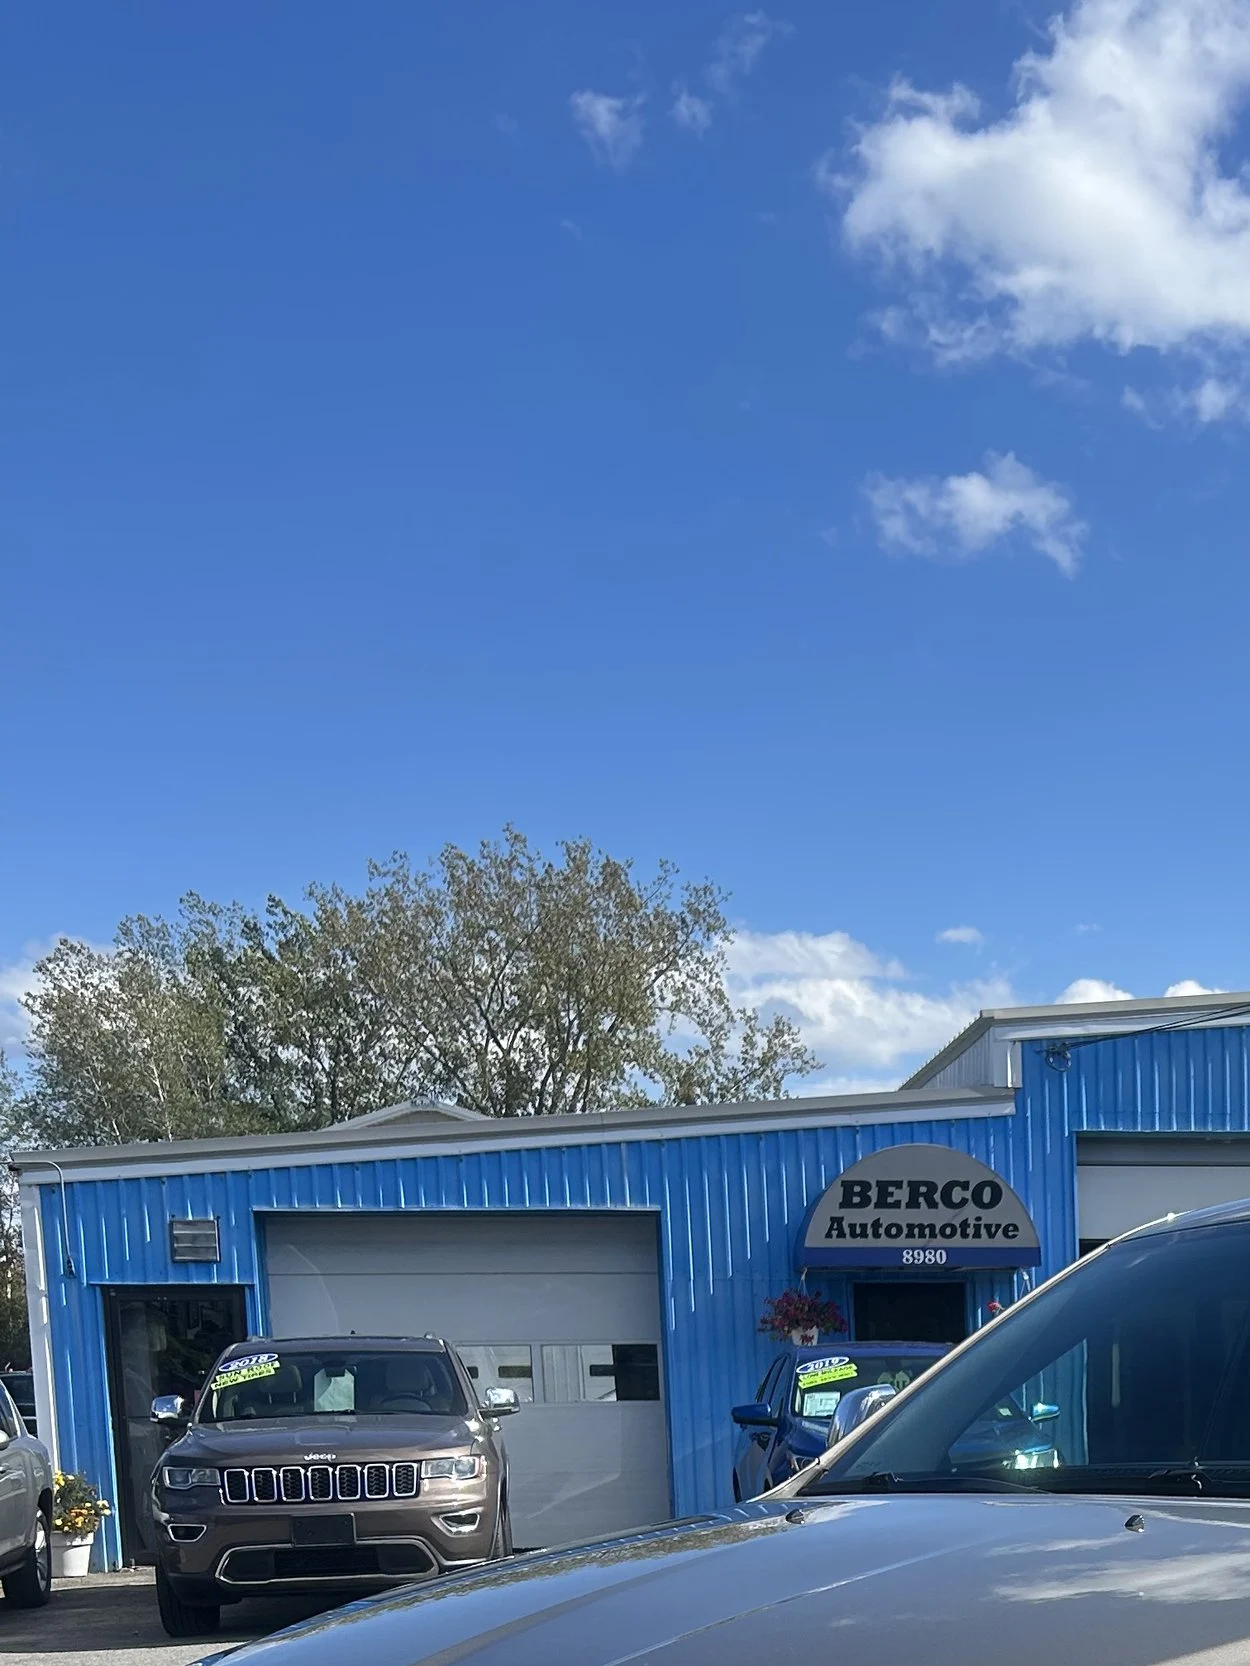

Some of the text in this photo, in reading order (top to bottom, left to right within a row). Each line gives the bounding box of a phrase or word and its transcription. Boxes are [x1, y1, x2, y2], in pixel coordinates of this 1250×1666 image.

[839, 1180, 1003, 1210] BERCO
[824, 1216, 1020, 1240] Automotive
[902, 1249, 947, 1265] 8980
[229, 1354, 269, 1371] 2018
[808, 1358, 840, 1371] 2019
[214, 1376, 239, 1388] NEW
[303, 1452, 336, 1462] Jeep
